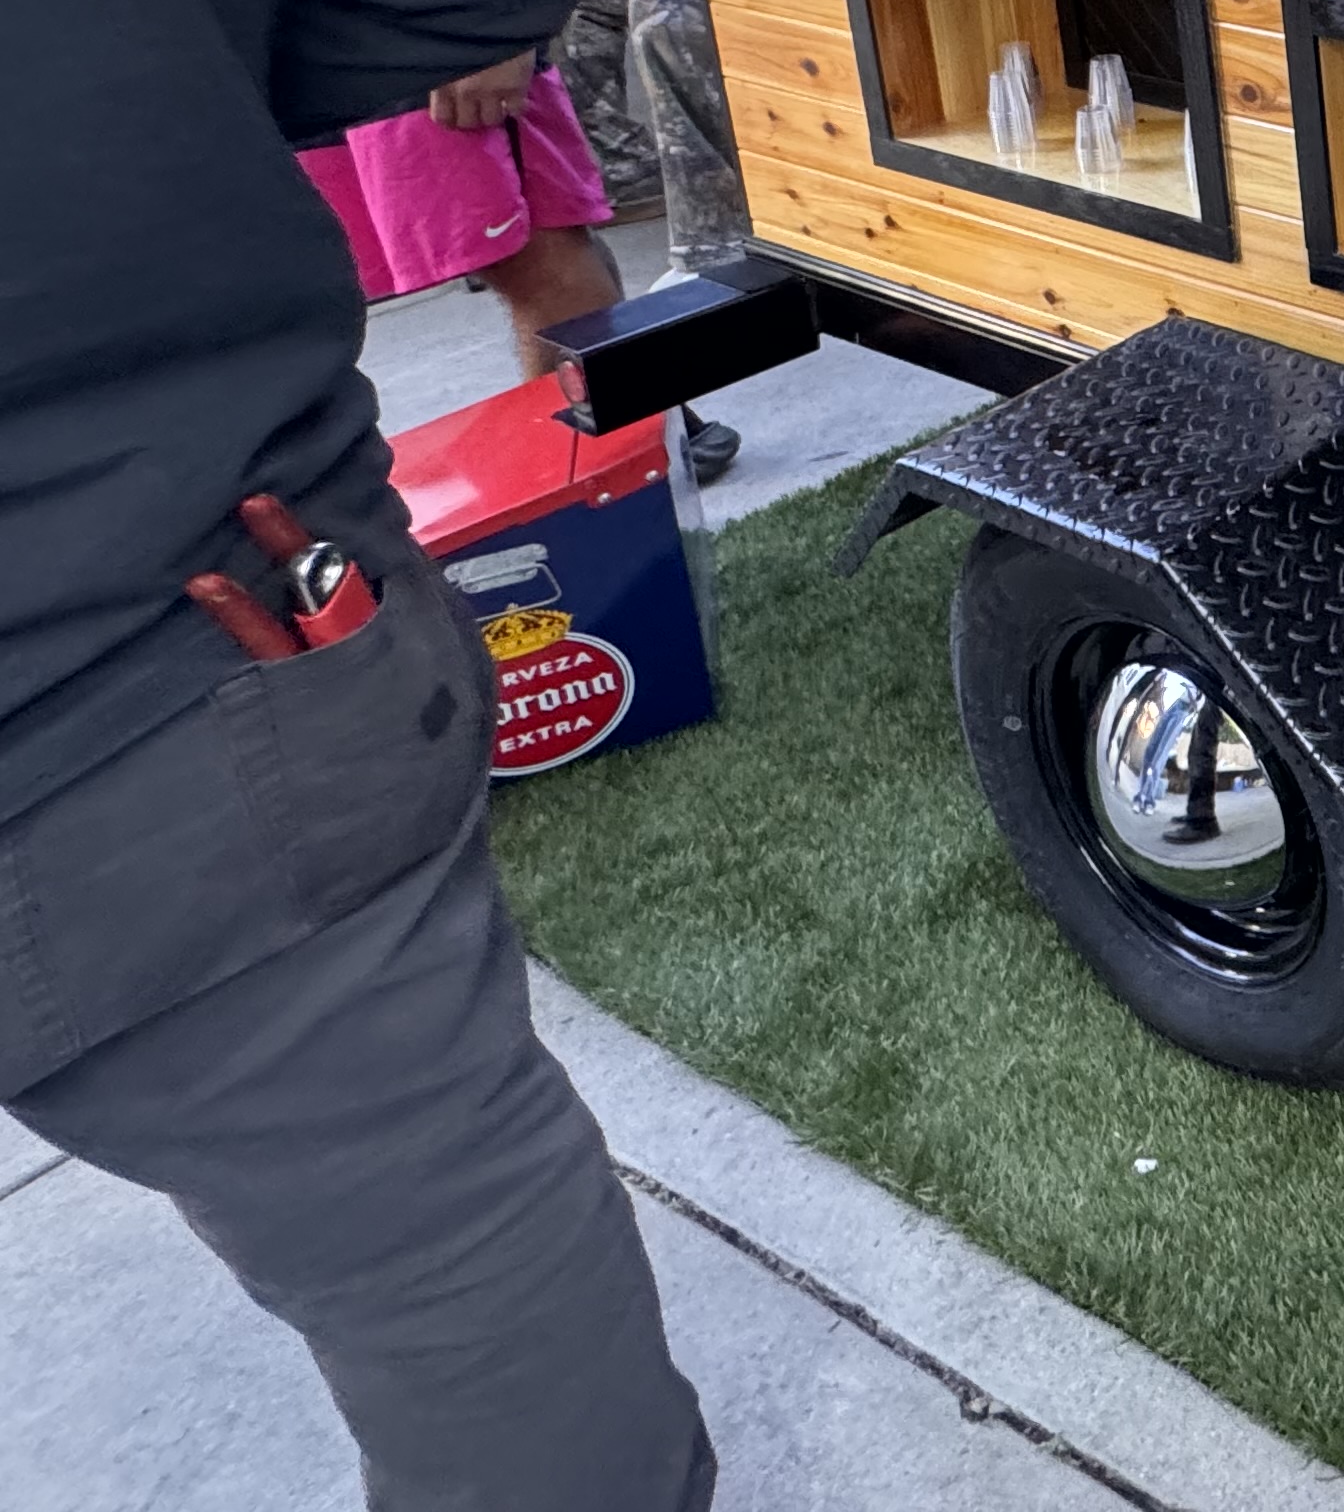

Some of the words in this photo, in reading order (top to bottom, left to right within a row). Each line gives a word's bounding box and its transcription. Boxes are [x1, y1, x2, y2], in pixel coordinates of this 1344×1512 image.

[501, 651, 594, 687] RVEZA
[497, 672, 618, 726] orona
[500, 715, 593, 753] EXTRA
